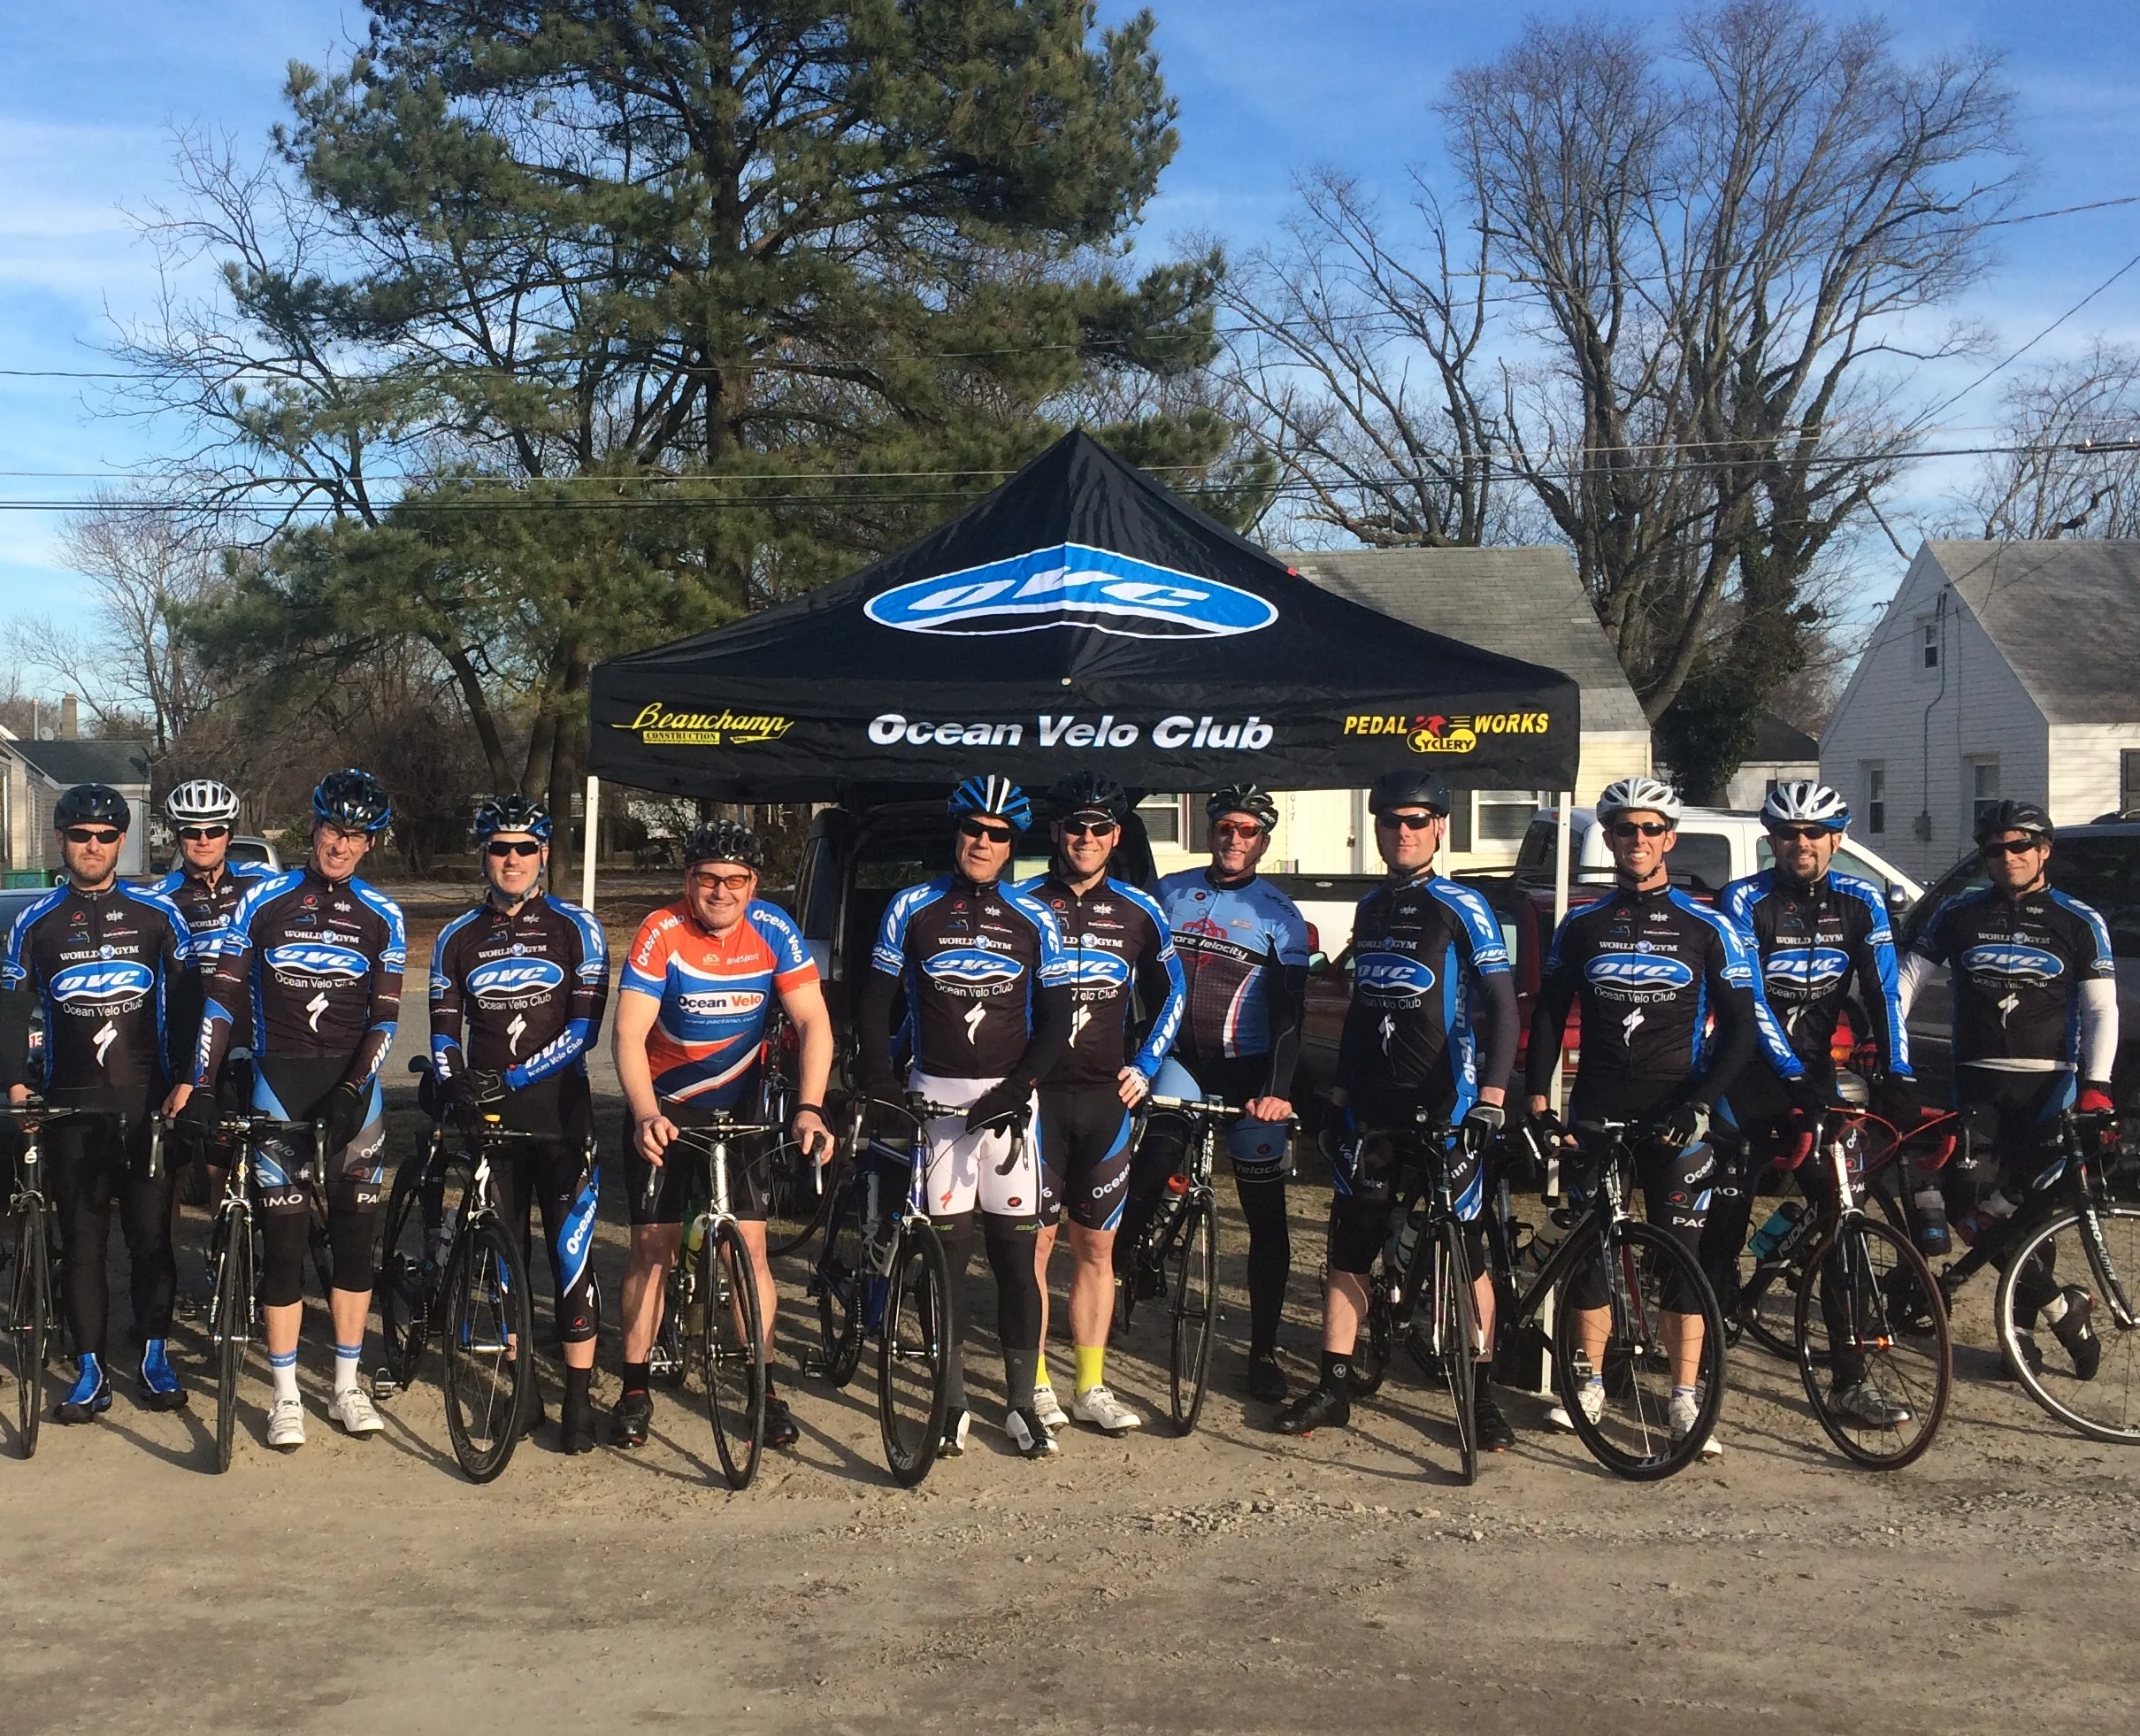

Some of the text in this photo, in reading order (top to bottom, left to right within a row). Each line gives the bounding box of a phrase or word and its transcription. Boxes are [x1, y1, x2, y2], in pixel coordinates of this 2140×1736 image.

[907, 566, 1210, 611] OVC
[612, 703, 794, 738] Beauchamp
[1344, 712, 1549, 734] PEDAL WORKS
[646, 731, 717, 741] CONSTRUCTION
[867, 713, 1274, 749] Ocean Velo Club
[1407, 729, 1474, 752] CYCLERY
[234, 876, 289, 926] OVC
[886, 886, 931, 944] OVC
[1435, 885, 1494, 941] OVC
[1015, 897, 1061, 955] OVC
[1690, 903, 1745, 958] OVC
[284, 930, 360, 944] WORLD GYM
[636, 914, 686, 967] Ocean Velo
[752, 909, 803, 964] Ocean Velo
[1097, 939, 1124, 949] GYM
[1776, 933, 1844, 945] WORLD GYM
[2026, 935, 2051, 945] GYM
[59, 945, 140, 961] WORLD GYM
[193, 939, 225, 951] OV
[478, 944, 548, 958] WORLD GYM
[988, 941, 1012, 950] GYM
[1392, 941, 1418, 950] GYM
[1653, 943, 1678, 952] GYM
[1068, 960, 1120, 973] VC
[1970, 953, 2049, 967] OVC
[472, 966, 548, 987] OVC
[1357, 964, 1417, 979] OVC
[1592, 963, 1678, 977] OVC
[57, 971, 141, 991] OVC
[275, 972, 309, 988] Ocean
[311, 978, 333, 988] Velo
[934, 981, 1014, 997] Ocean Velo Club
[1097, 989, 1119, 1000] Club
[1595, 987, 1676, 1003] Ocean Velo Club
[63, 998, 144, 1018] Ocean Velo Club
[478, 993, 552, 1010] Ocean Velo Club
[678, 992, 762, 1008] Ocean Velo
[1398, 997, 1423, 1010] Club
[525, 1029, 572, 1069] OVC
[567, 1037, 585, 1055] Club
[1458, 1036, 1477, 1085] Velo
[567, 1200, 597, 1255] Ocean
[1777, 1201, 1819, 1255] RIDLEY
